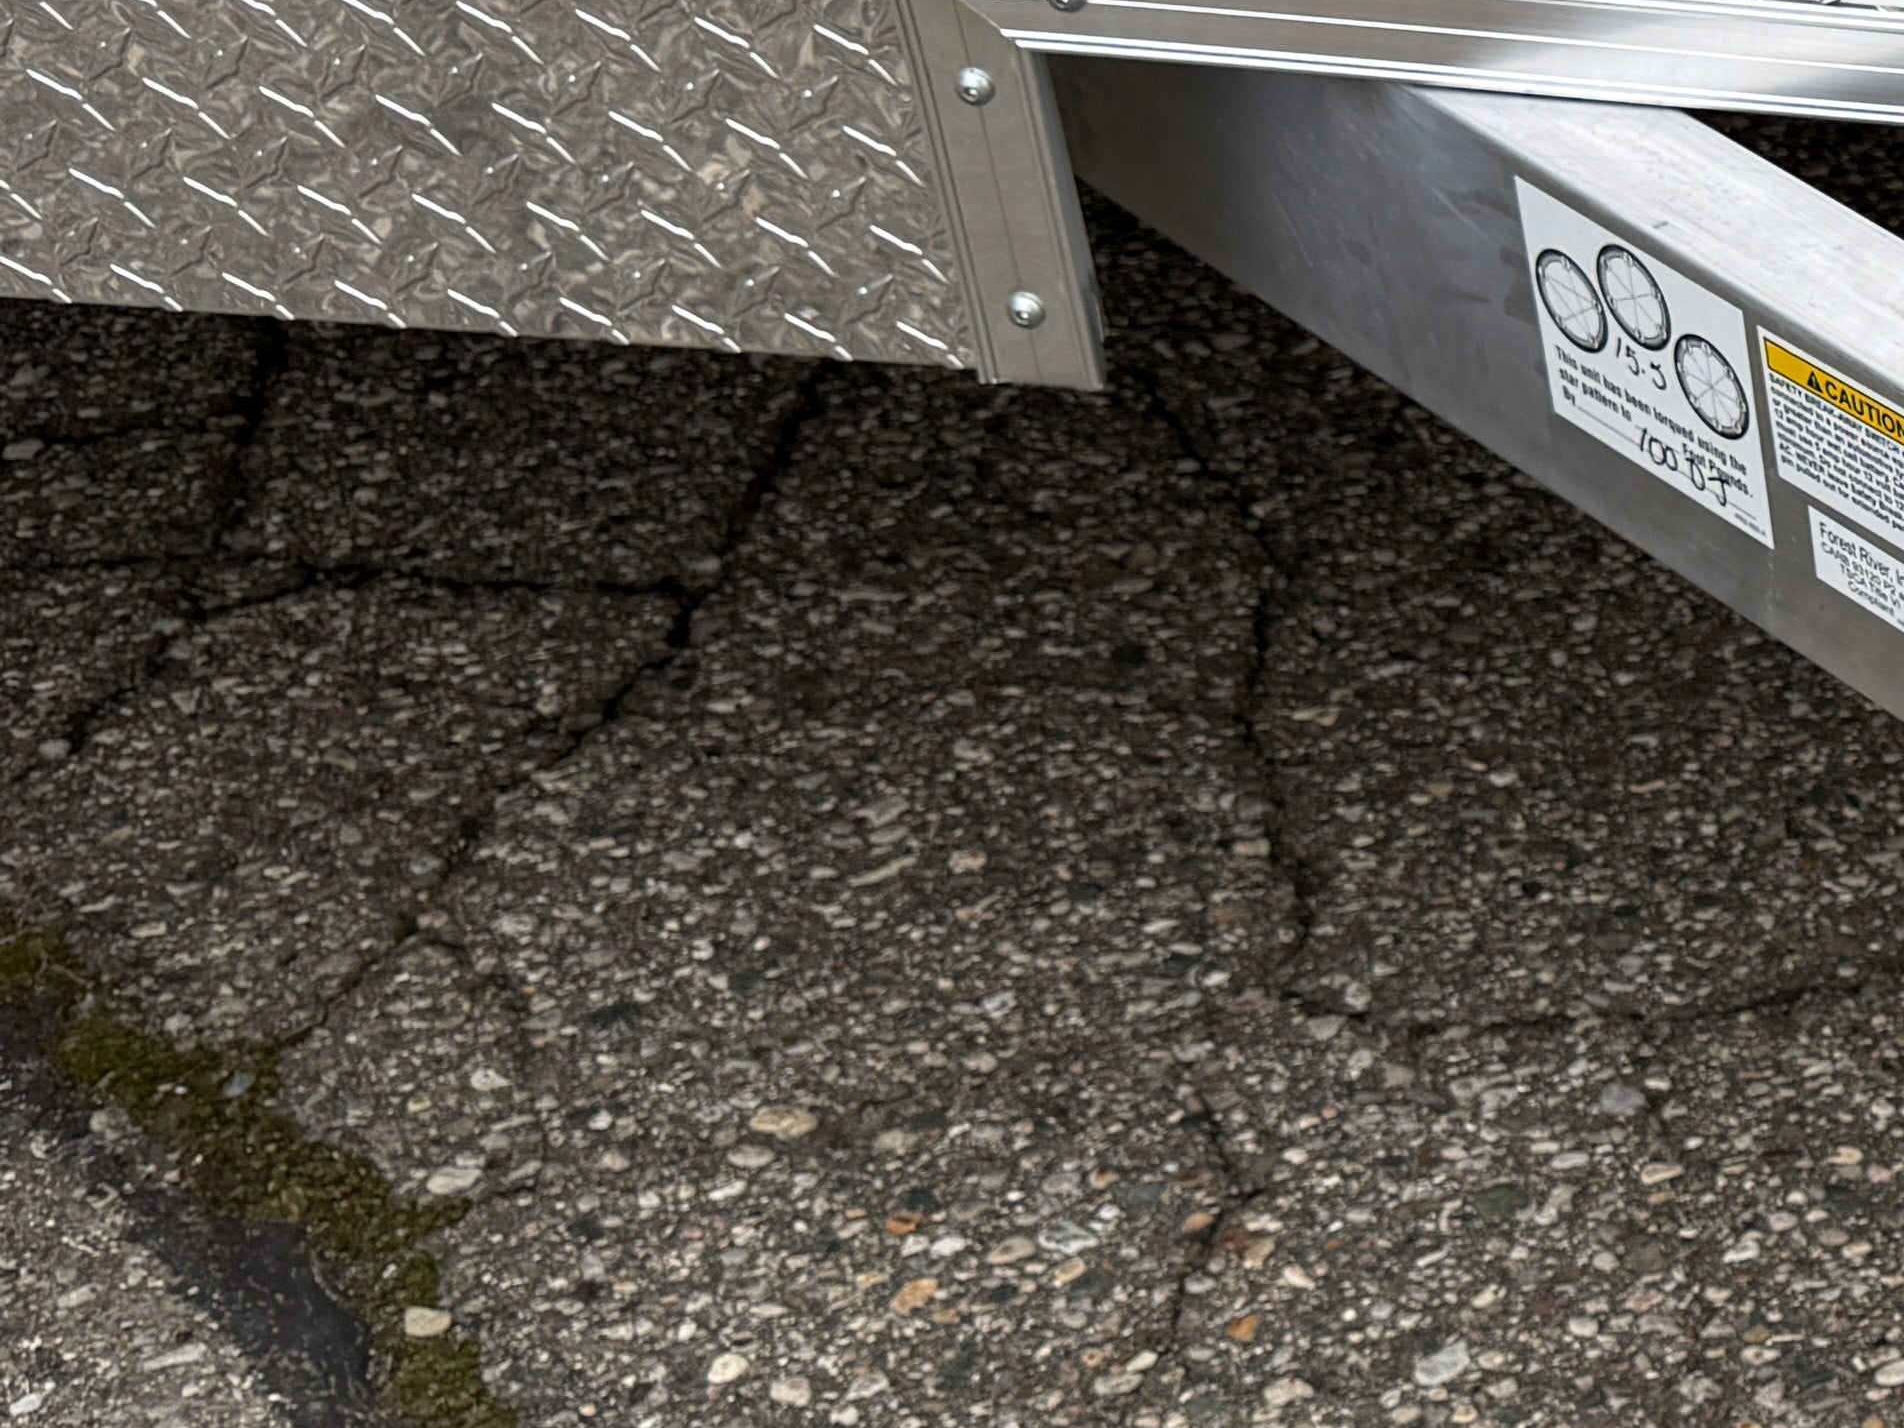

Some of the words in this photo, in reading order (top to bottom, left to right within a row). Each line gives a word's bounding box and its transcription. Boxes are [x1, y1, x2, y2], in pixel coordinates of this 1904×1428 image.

[1554, 344, 1578, 370] This
[1580, 364, 1601, 384] unit
[1602, 375, 1622, 398] has
[1624, 389, 1651, 414] been
[1652, 407, 1694, 442] torqued
[1697, 436, 1727, 465] using
[1728, 454, 1746, 475] the
[1558, 368, 1578, 387] star
[1581, 382, 1618, 412] pattern
[1620, 404, 1631, 421] to
[1561, 385, 1575, 406] By
[1638, 427, 1678, 471] 100
[1818, 521, 1856, 557] Forest
[1858, 546, 1892, 581] River,
